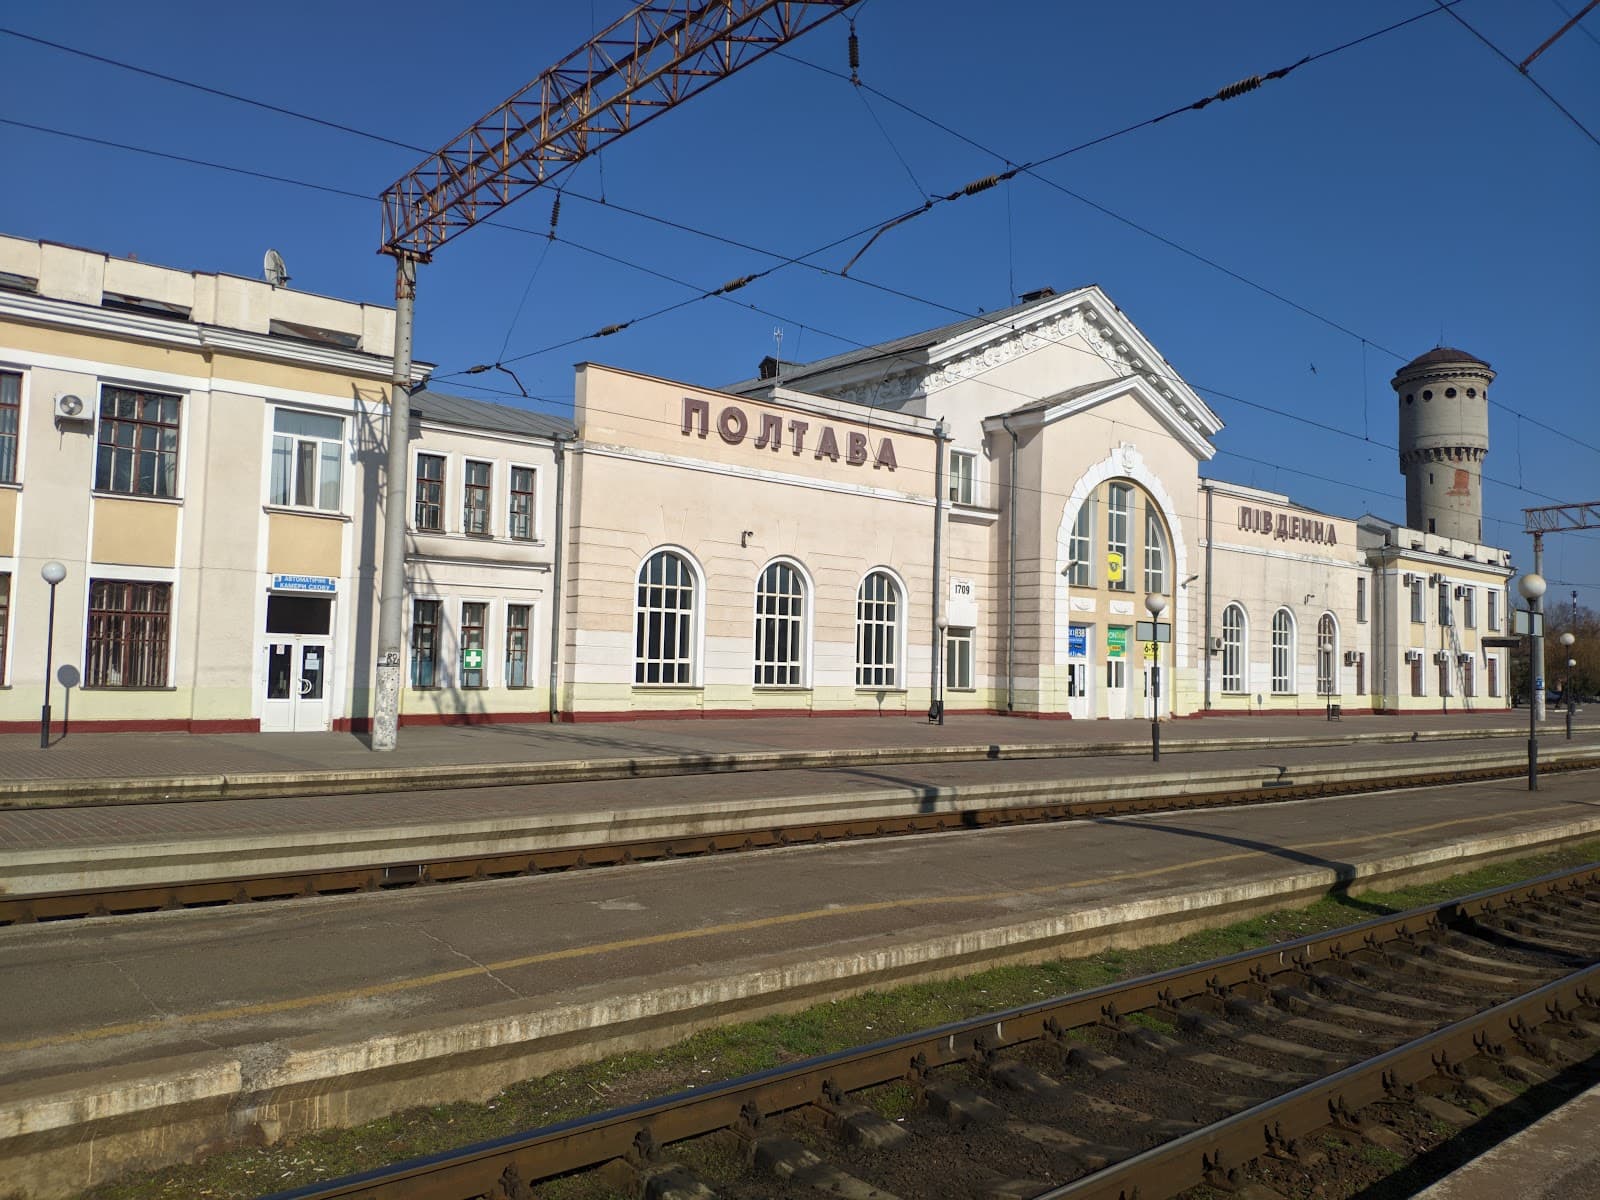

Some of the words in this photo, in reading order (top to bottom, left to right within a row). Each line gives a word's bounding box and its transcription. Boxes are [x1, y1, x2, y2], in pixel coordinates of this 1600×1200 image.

[681, 397, 898, 472] ПОЛТАВА
[1238, 506, 1337, 546] ПІВДЕННА
[955, 584, 970, 595] 1709
